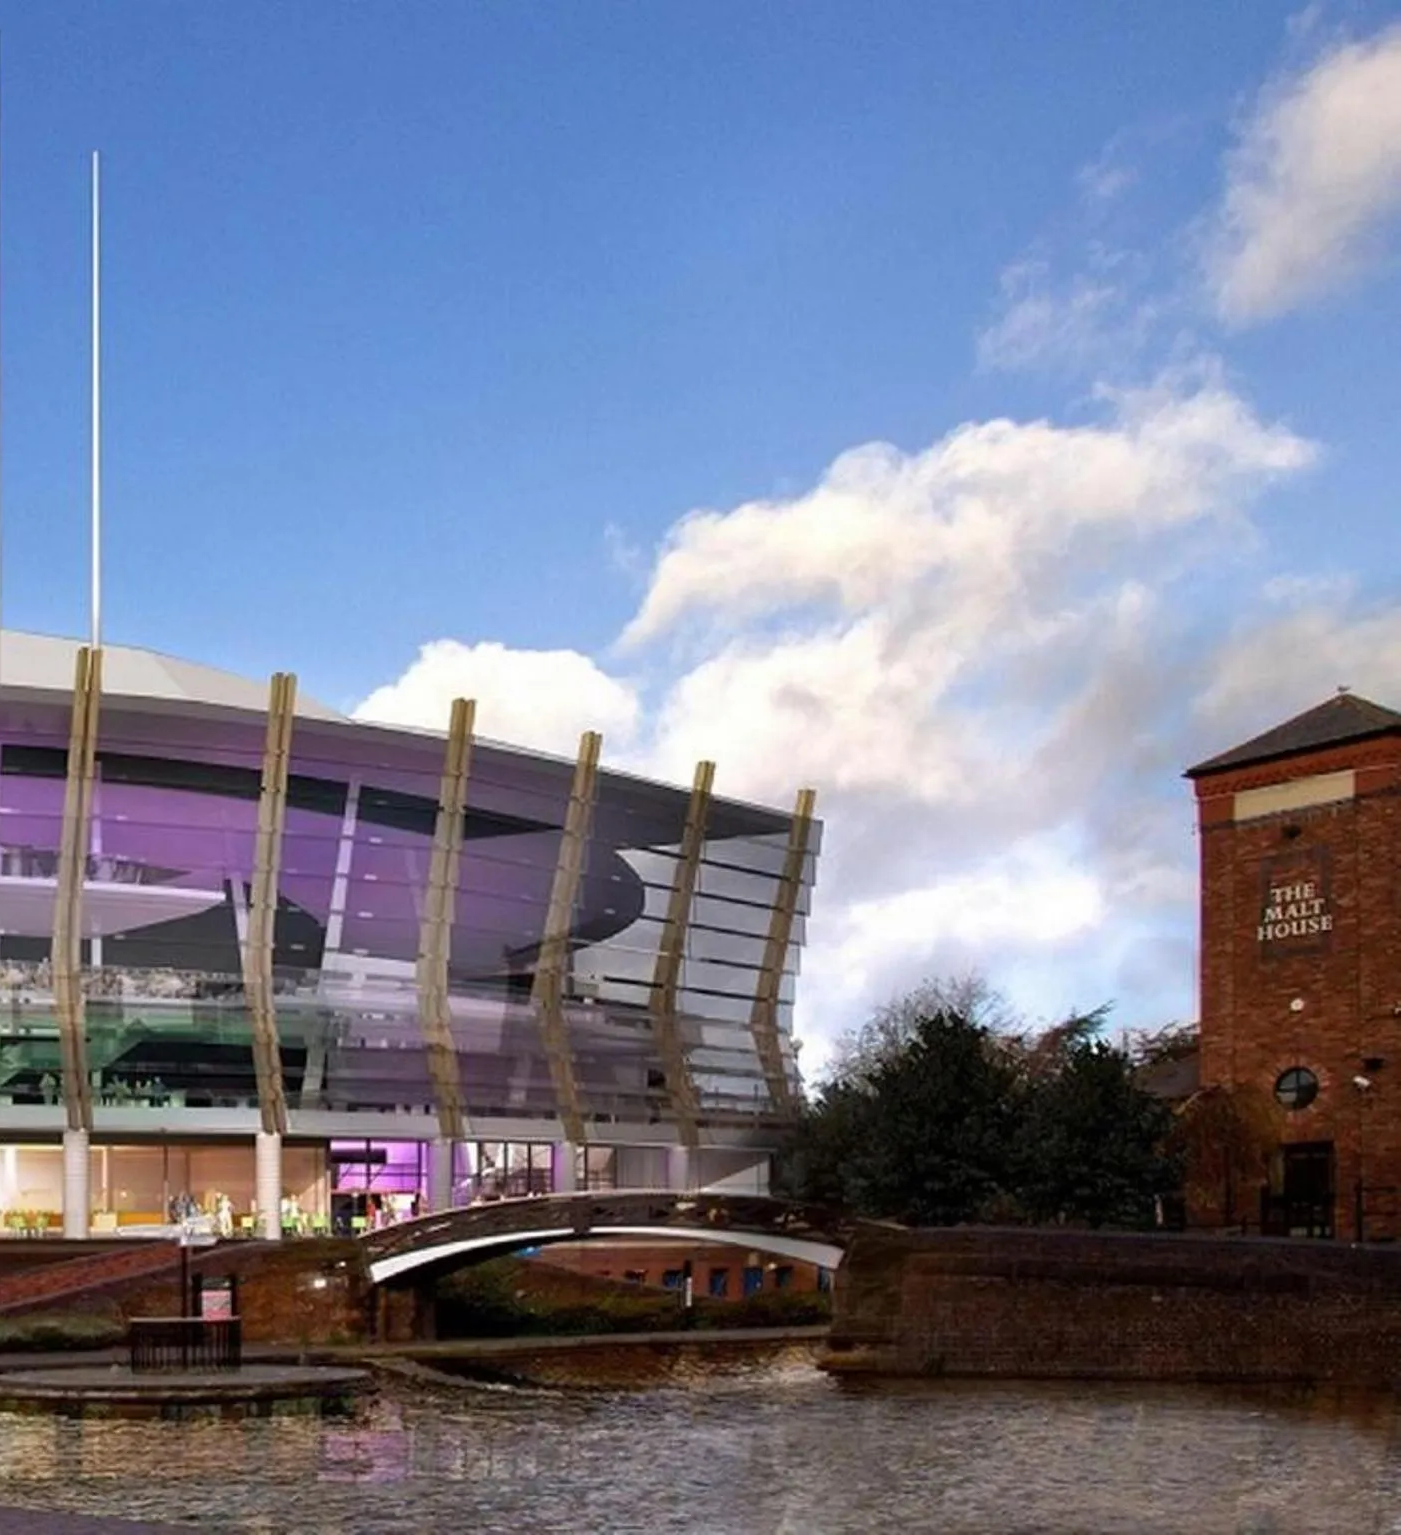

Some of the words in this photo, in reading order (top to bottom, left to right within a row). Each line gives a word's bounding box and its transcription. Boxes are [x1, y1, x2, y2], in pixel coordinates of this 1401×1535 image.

[1270, 883, 1315, 903] THE
[1264, 898, 1325, 923] MALT
[1257, 915, 1333, 941] HOUSE
